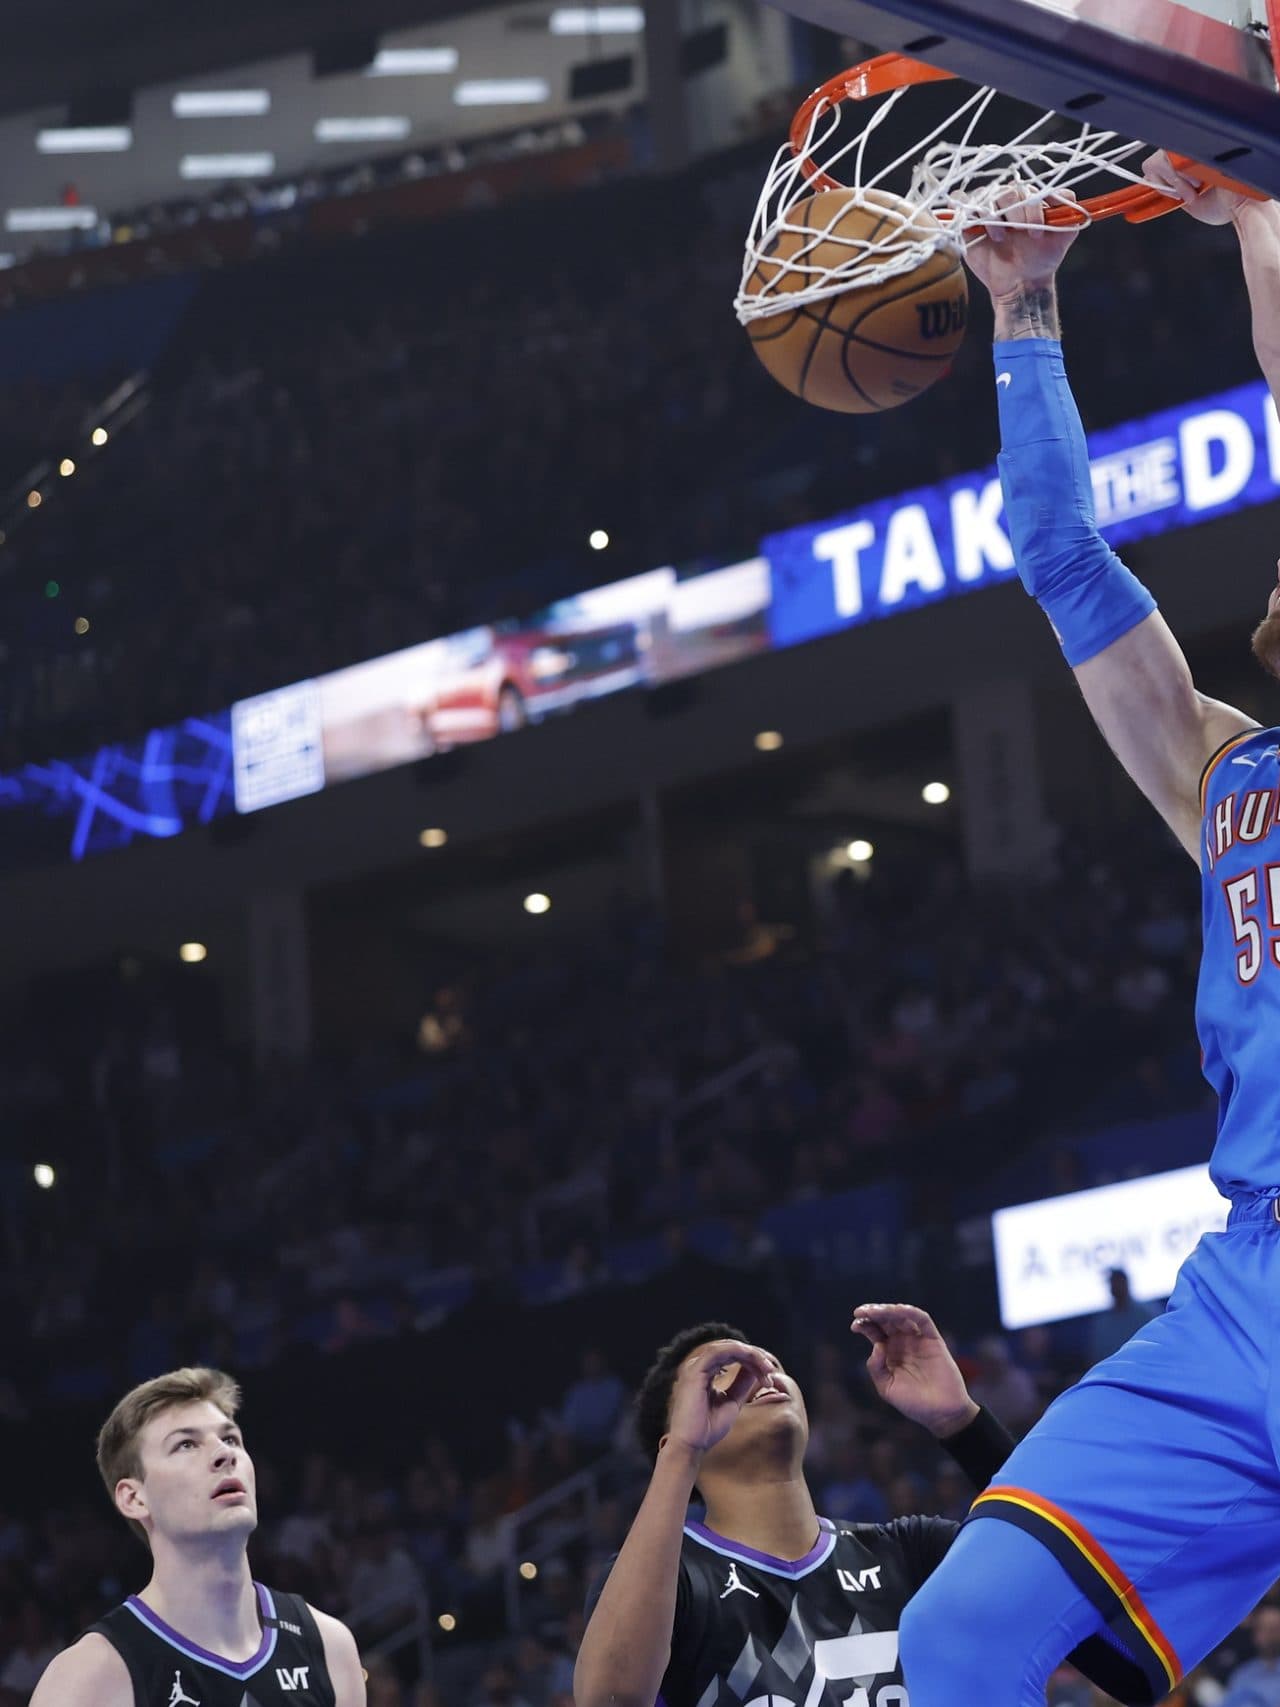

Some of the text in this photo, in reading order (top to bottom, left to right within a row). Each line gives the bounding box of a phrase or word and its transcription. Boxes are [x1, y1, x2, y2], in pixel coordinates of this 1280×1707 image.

[812, 477, 1015, 619] TAK
[1092, 439, 1180, 517] THE
[836, 1564, 882, 1593] LVT
[275, 1666, 310, 1691] LVT
